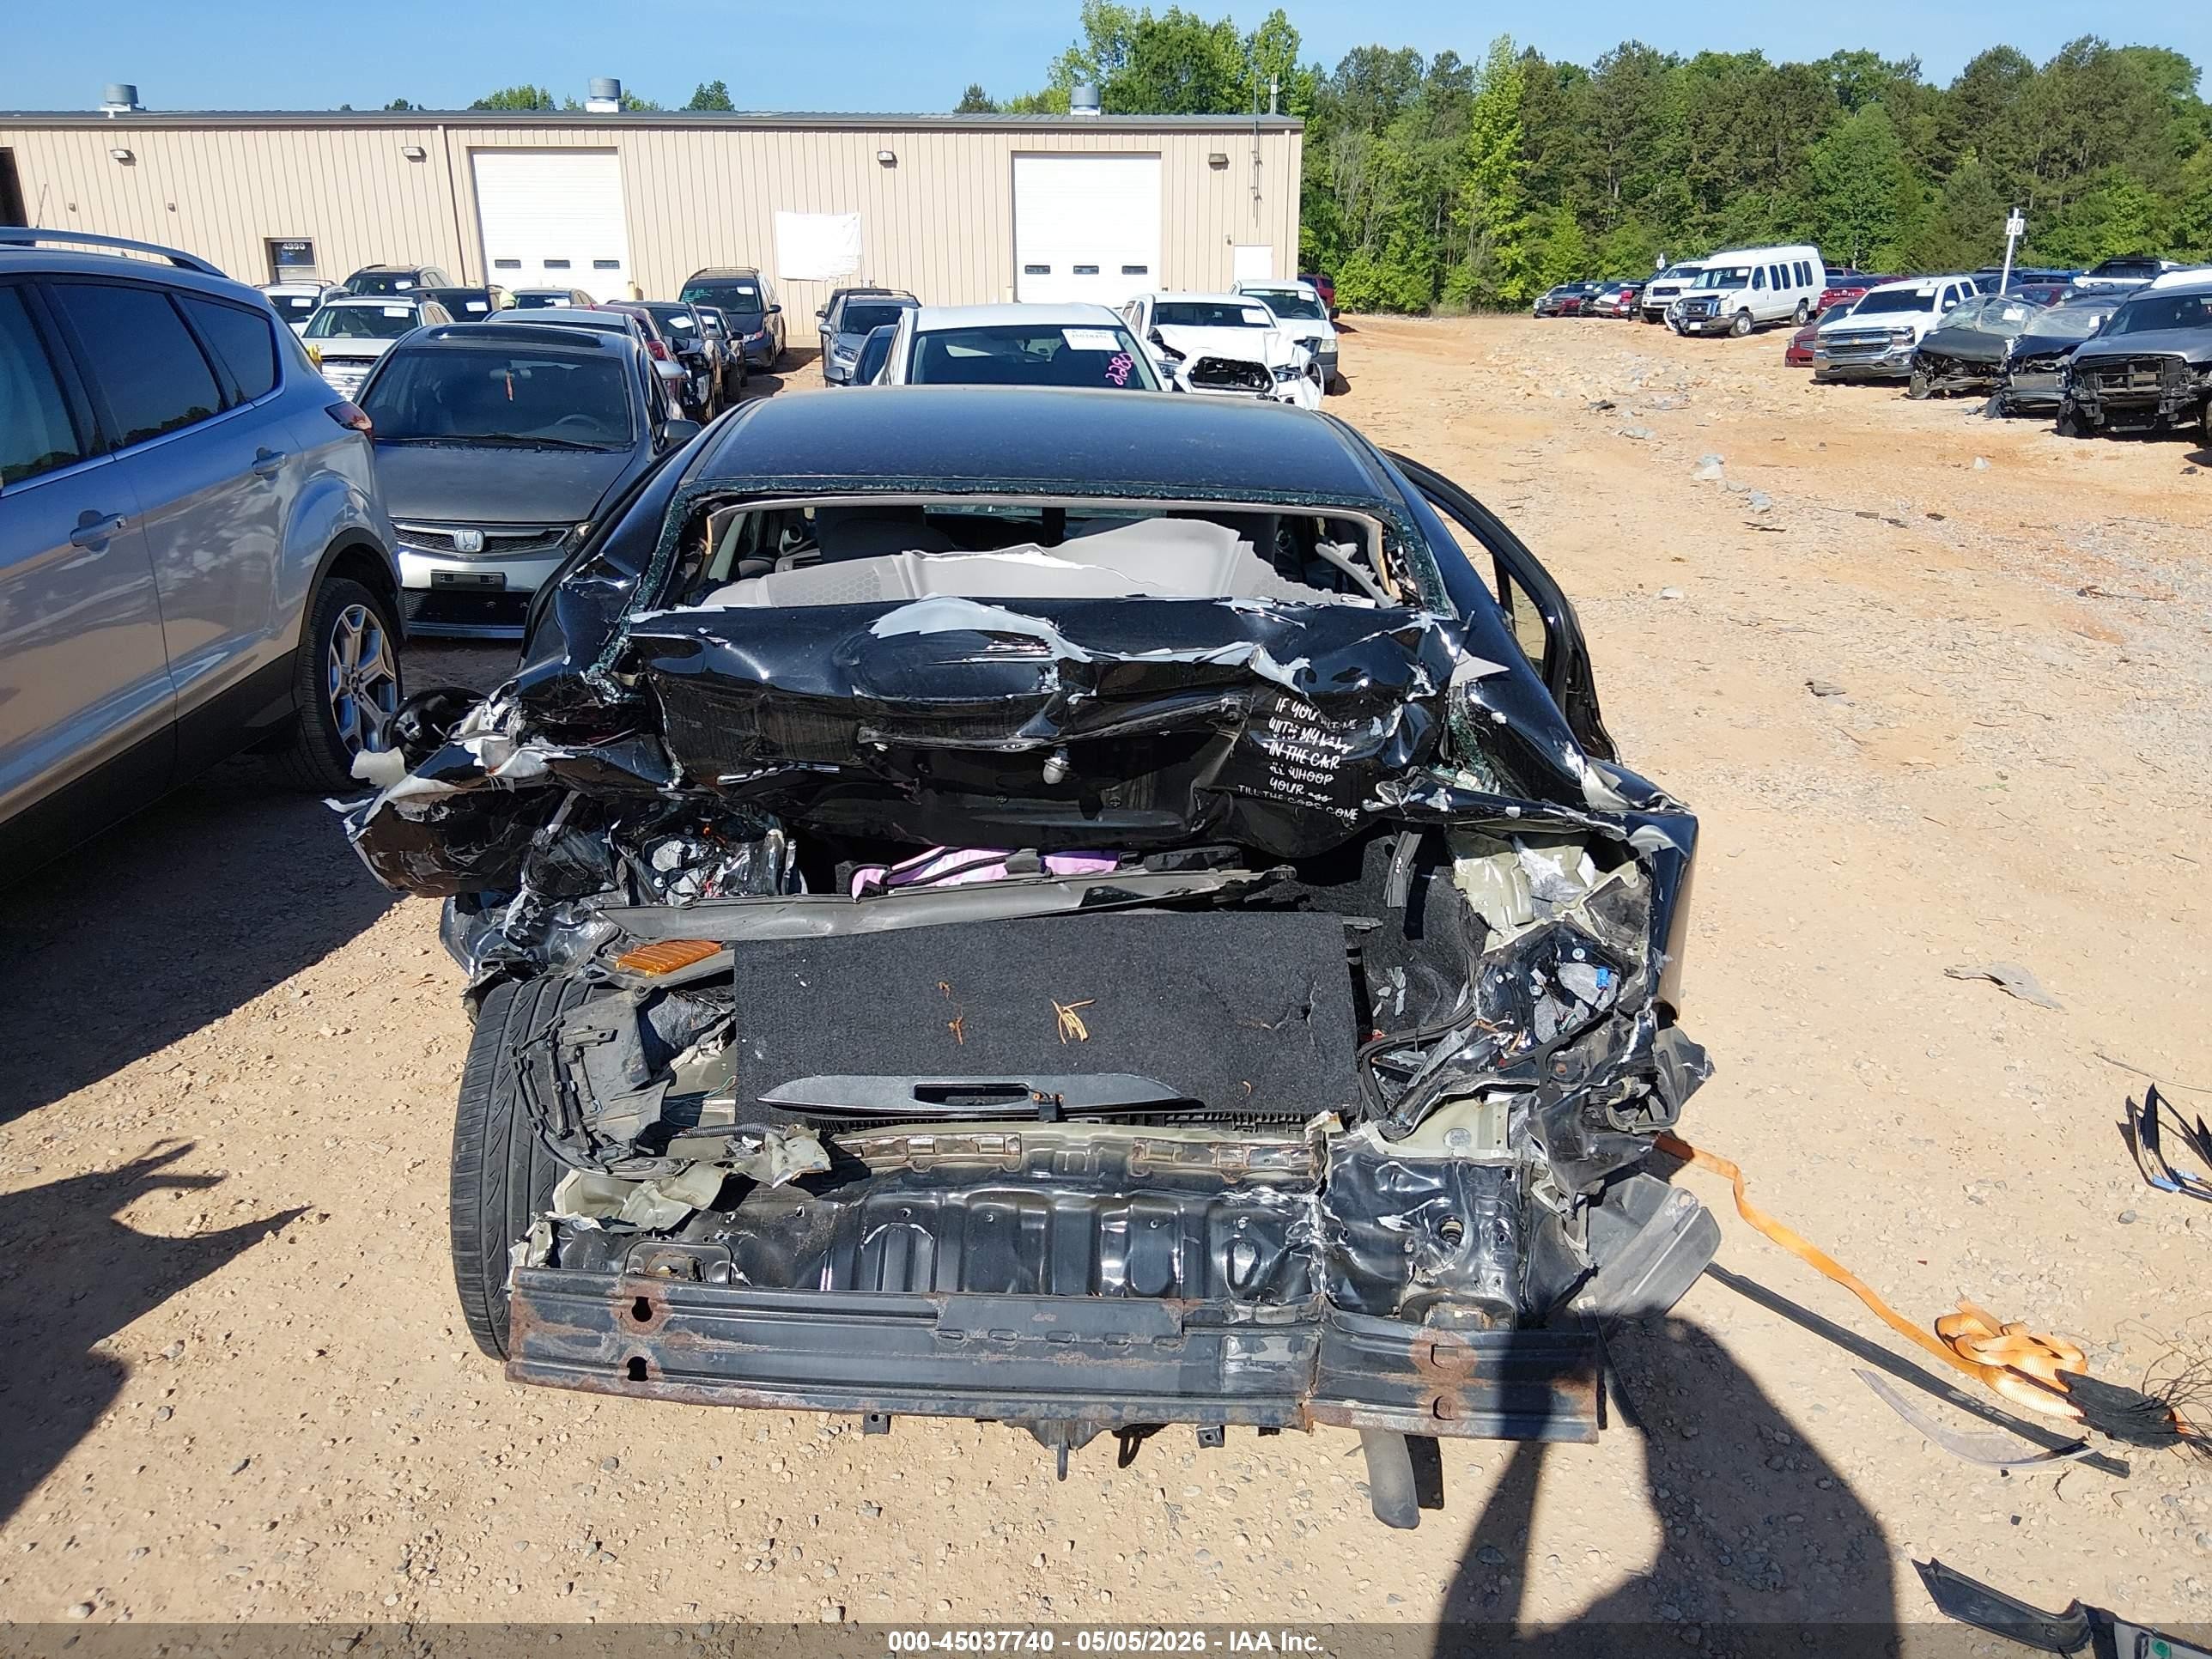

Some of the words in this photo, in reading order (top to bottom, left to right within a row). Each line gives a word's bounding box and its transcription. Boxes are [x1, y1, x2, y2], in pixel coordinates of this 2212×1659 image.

[1274, 696, 1290, 713] IF
[1291, 700, 1321, 721] YOU
[1299, 726, 1321, 746] MY
[1268, 741, 1285, 757] IN
[1285, 744, 1310, 764] THE
[1310, 752, 1340, 770] CAR
[1269, 777, 1305, 795] YOUR
[1288, 766, 1334, 786] WHOOP
[1237, 784, 1260, 797] TILL
[1326, 805, 1359, 821] COME
